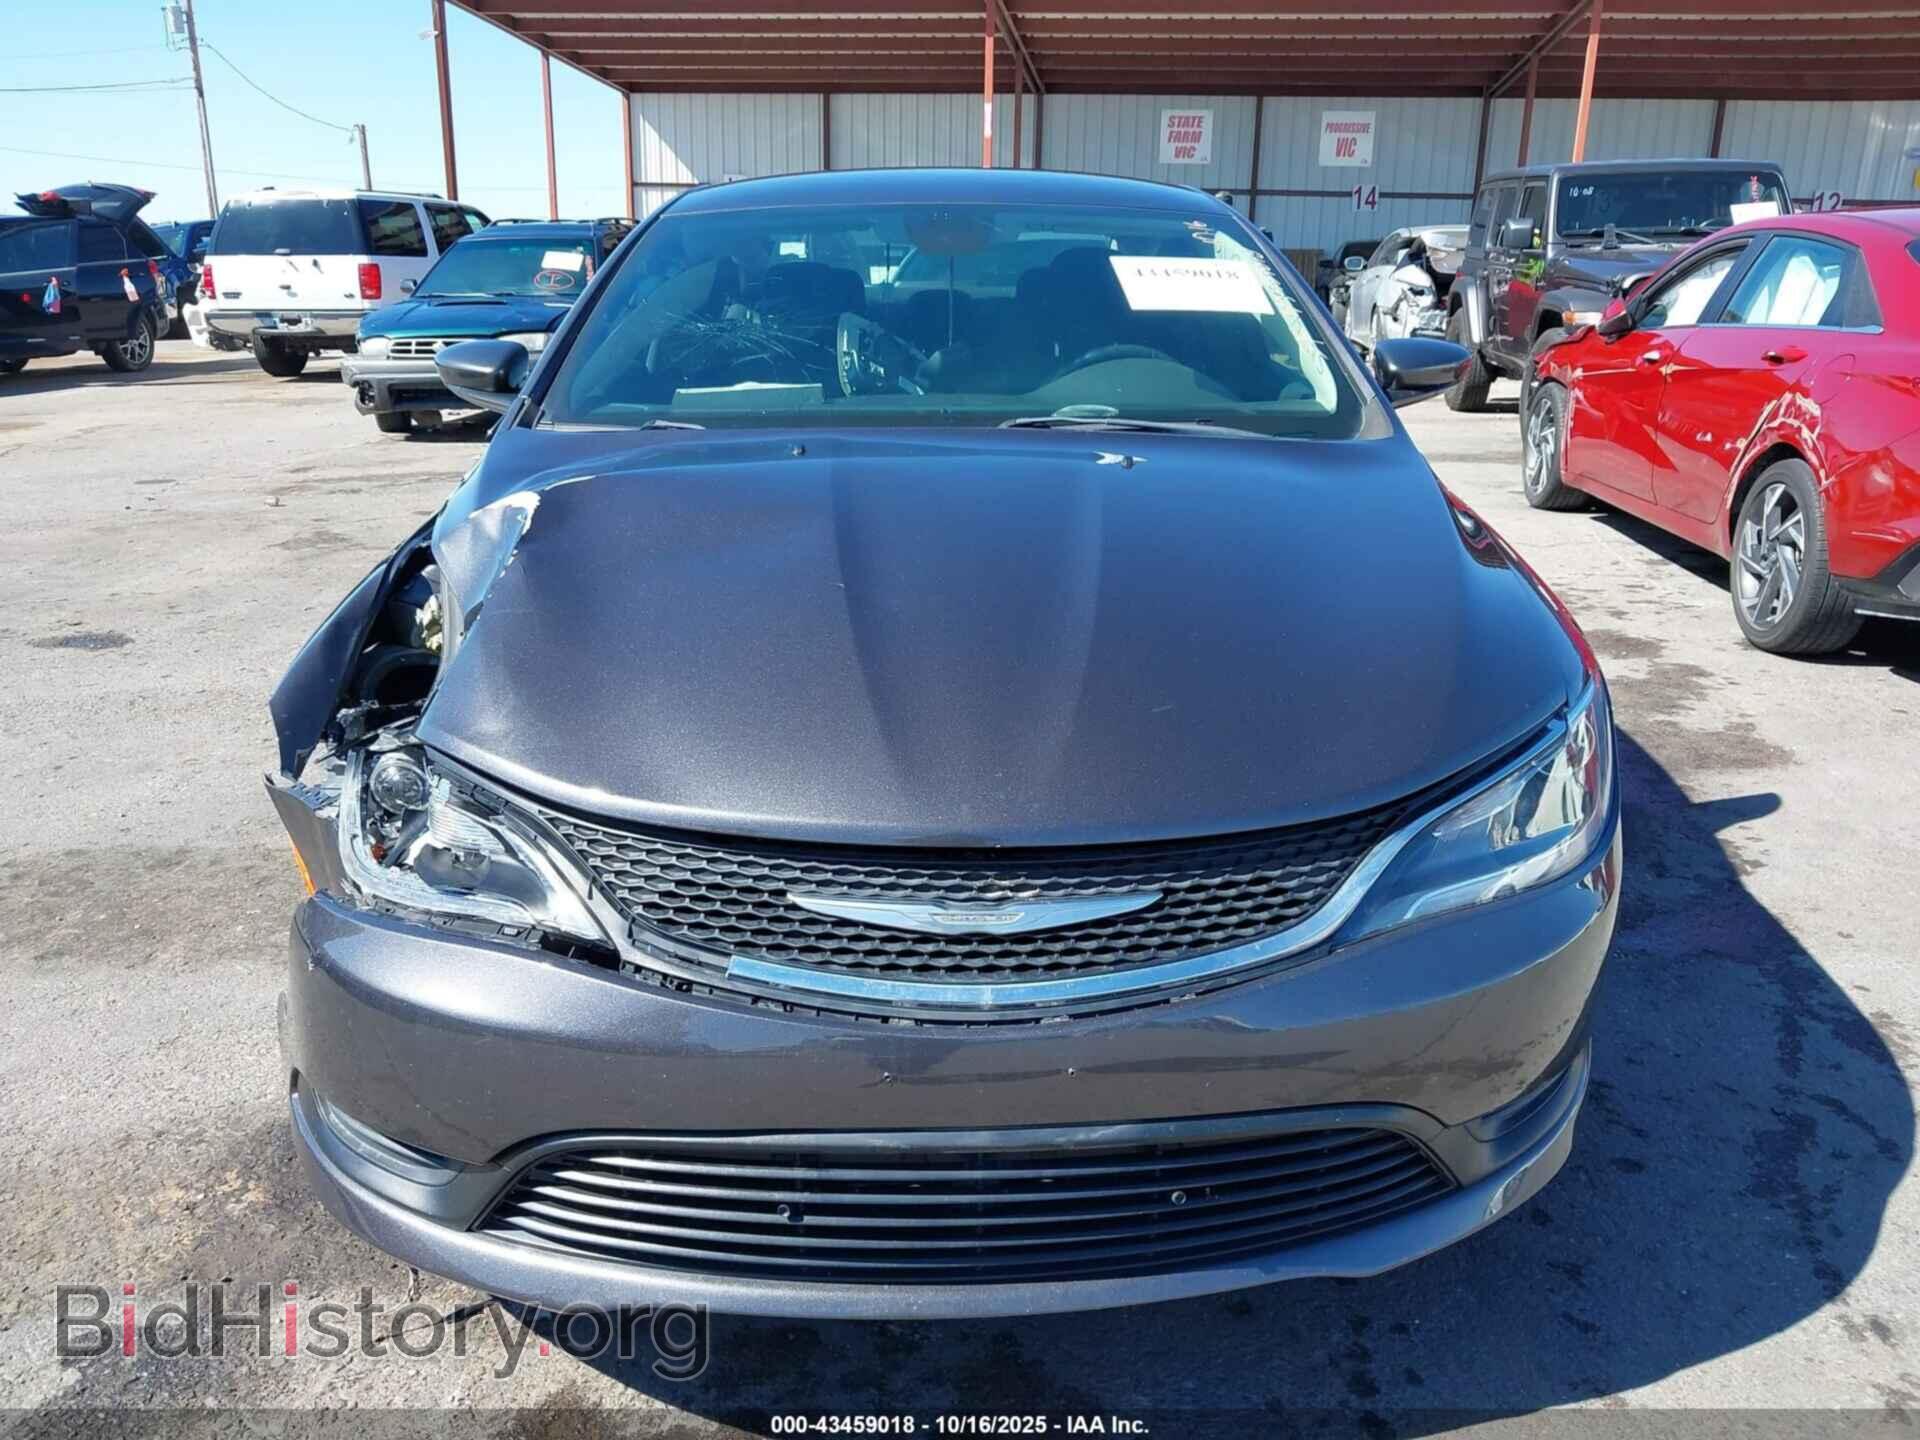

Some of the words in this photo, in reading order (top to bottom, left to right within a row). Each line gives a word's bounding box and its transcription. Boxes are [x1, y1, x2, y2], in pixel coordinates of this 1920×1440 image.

[1168, 115, 1205, 129] STATE
[1325, 122, 1372, 134] PROGRESSIVE
[1168, 130, 1203, 144] FARM
[1175, 145, 1197, 159] VIC
[1335, 136, 1358, 158] VIC
[1354, 185, 1377, 210] 14
[1814, 191, 1841, 212] 12
